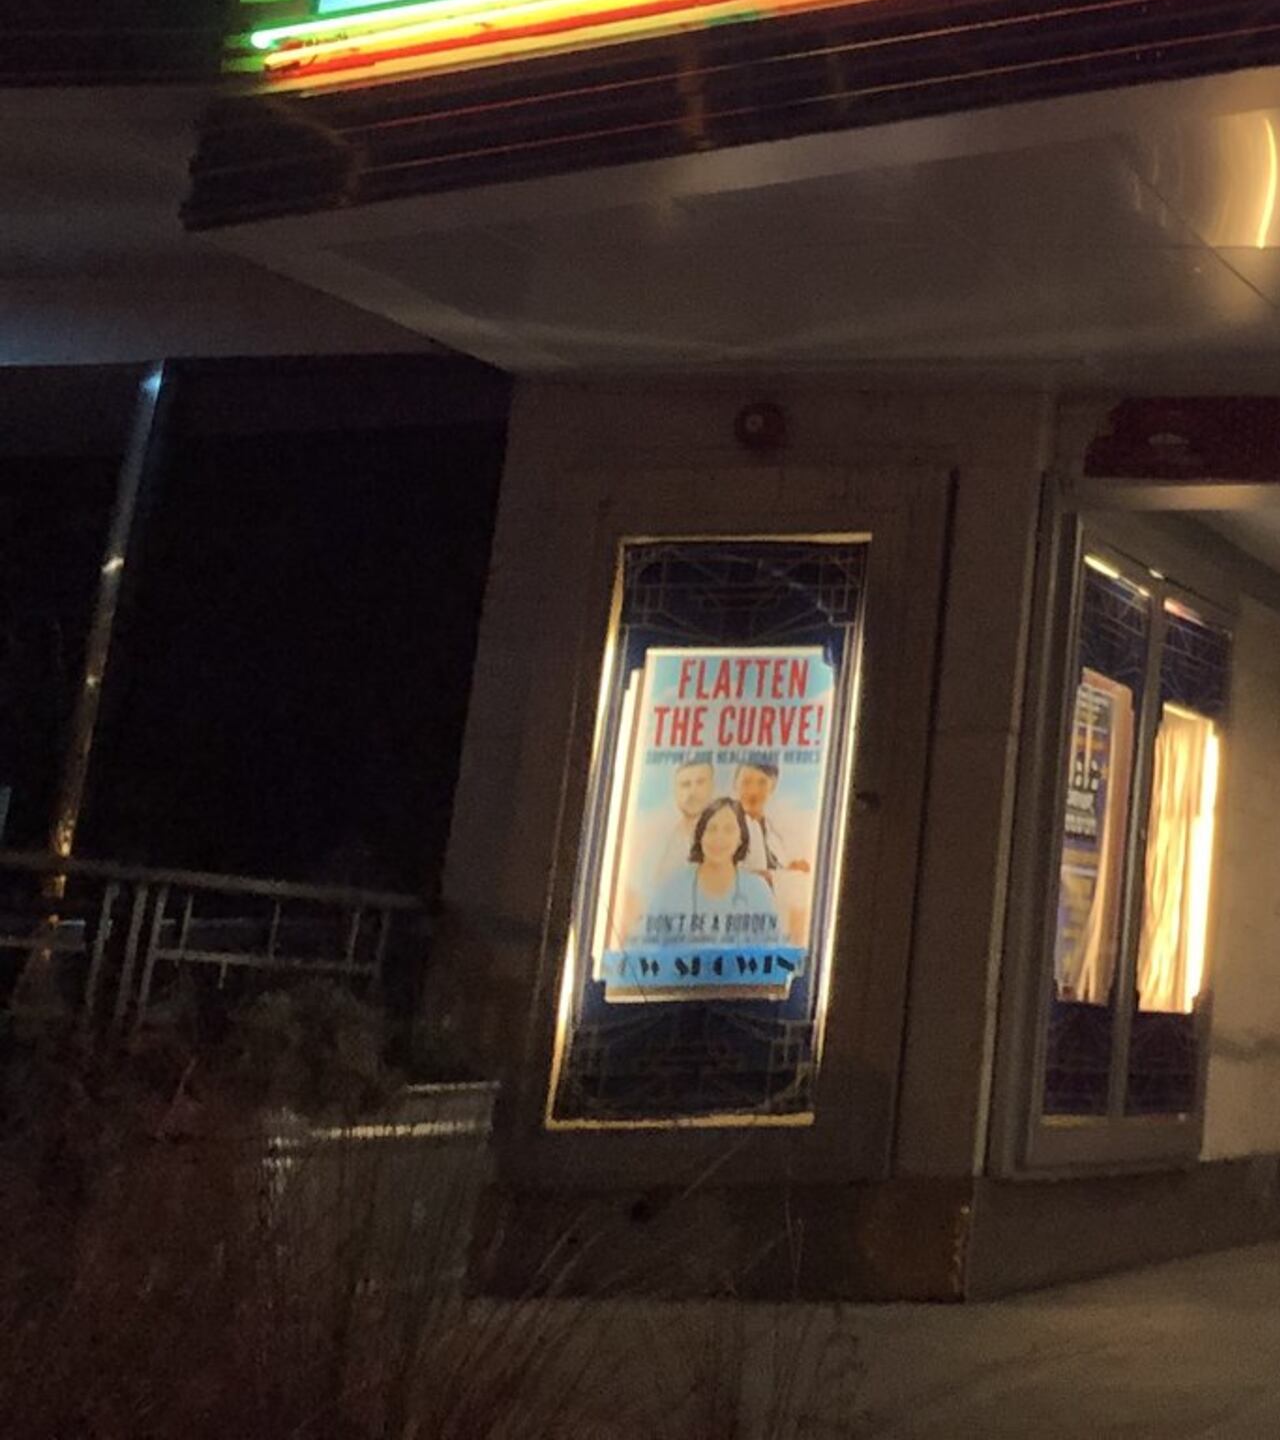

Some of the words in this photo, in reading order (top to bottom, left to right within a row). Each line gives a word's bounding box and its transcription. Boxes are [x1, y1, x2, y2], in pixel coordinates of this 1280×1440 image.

[678, 658, 809, 700] FLATTEN
[654, 706, 709, 748] THE
[717, 705, 825, 748] CURVE!
